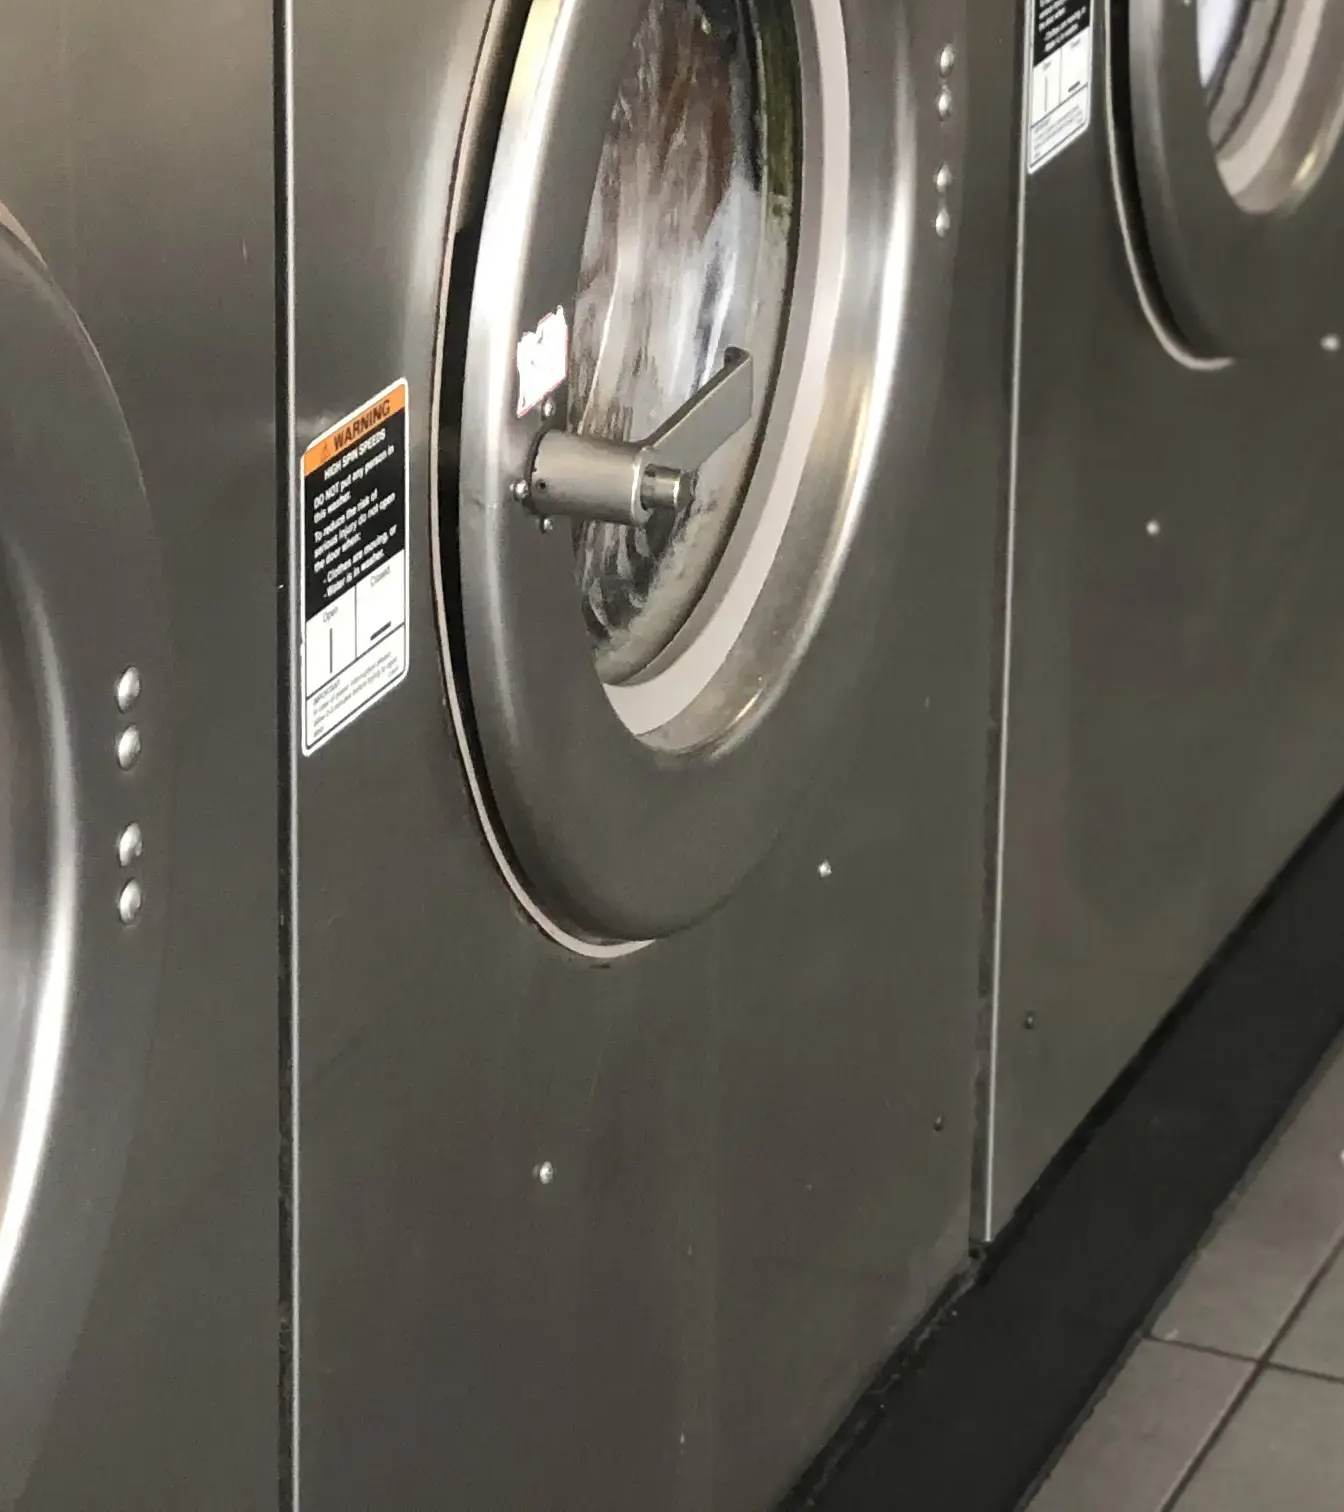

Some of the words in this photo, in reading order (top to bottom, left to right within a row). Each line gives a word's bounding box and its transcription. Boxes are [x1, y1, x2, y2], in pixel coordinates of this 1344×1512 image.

[334, 399, 391, 451] WARNING
[324, 460, 341, 481] HIGH
[342, 448, 358, 468] SPIN
[359, 428, 385, 456] SPEEDS
[314, 493, 324, 509] DO
[325, 481, 339, 500] NOT
